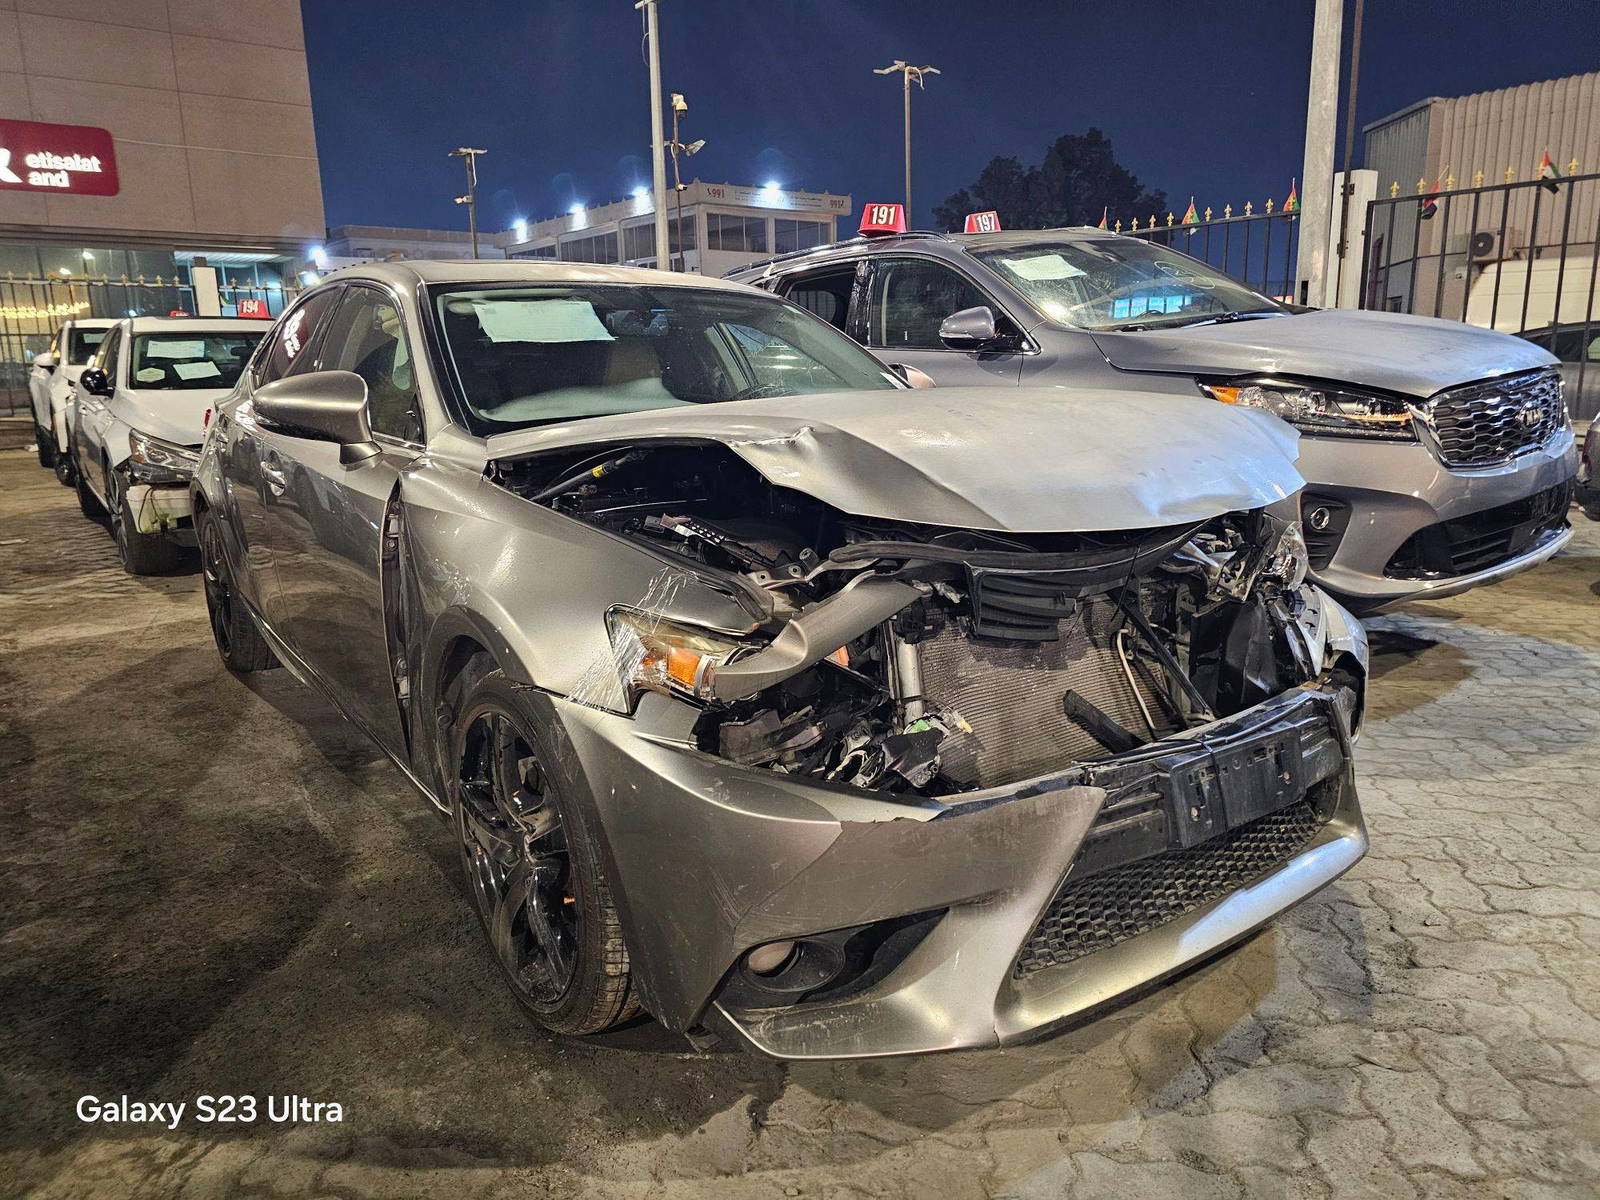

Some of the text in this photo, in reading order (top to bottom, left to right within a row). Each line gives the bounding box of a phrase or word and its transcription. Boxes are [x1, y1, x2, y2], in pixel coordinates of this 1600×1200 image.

[25, 151, 102, 172] etisalat
[28, 170, 70, 187] and
[872, 206, 896, 225] 191
[977, 213, 995, 231] 197
[242, 300, 259, 313] 194
